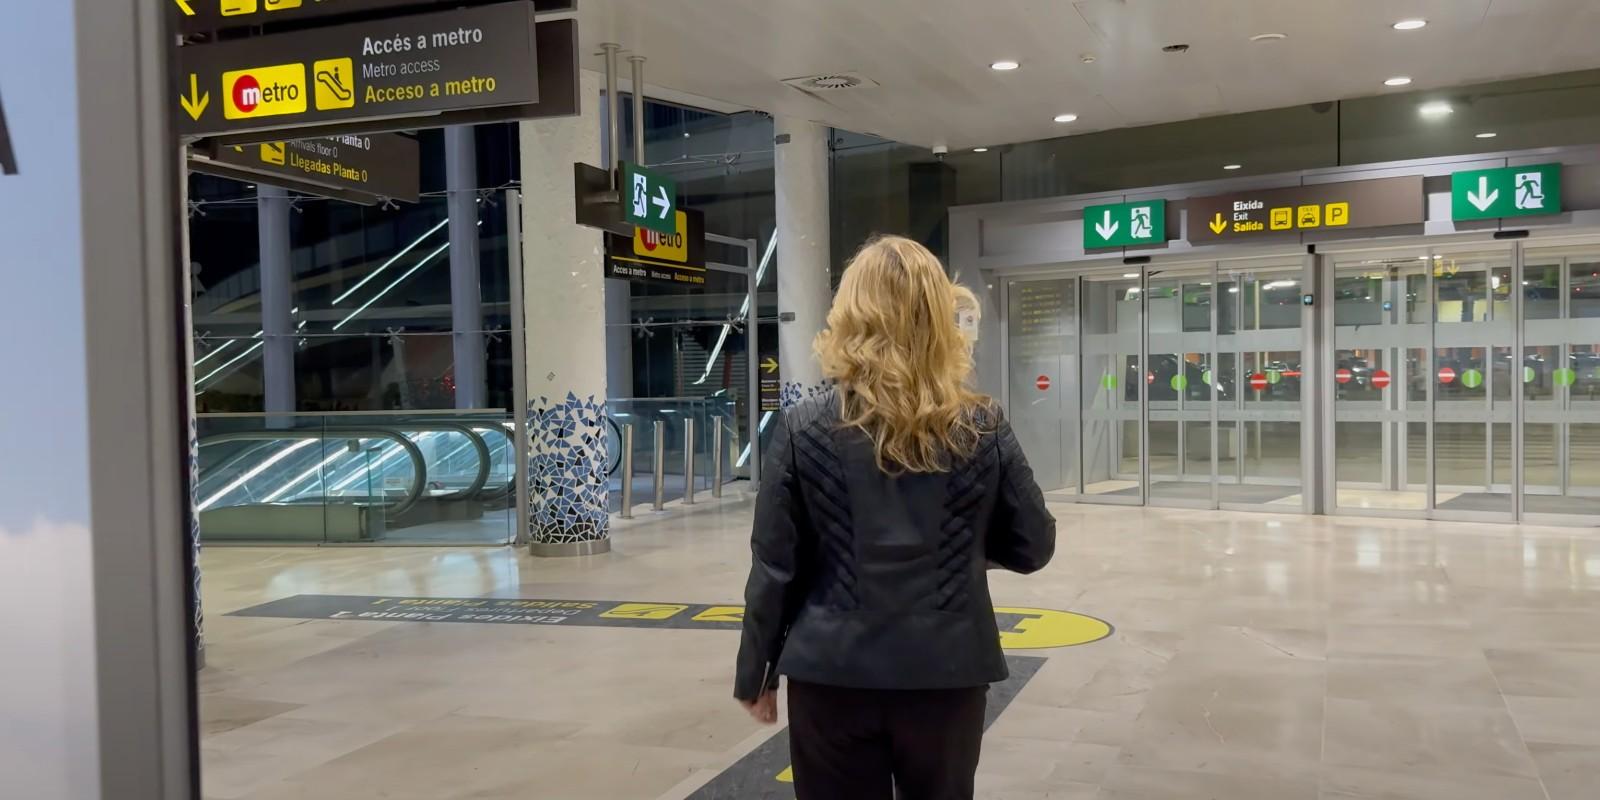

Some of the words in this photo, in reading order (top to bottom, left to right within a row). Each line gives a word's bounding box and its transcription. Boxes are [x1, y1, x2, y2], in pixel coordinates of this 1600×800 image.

[362, 33, 412, 56] Accés
[417, 35, 427, 49] a
[432, 27, 483, 48] metro
[362, 62, 397, 79] Metro
[400, 58, 441, 75] access
[242, 81, 299, 106] metro
[365, 81, 424, 104] Acceso
[429, 82, 440, 97] a
[445, 75, 496, 95] metro
[364, 137, 370, 150] 0
[332, 147, 338, 158] 0
[290, 152, 331, 175] Llegadas
[333, 162, 360, 181] Planta
[361, 169, 368, 183] 0
[1233, 200, 1263, 211] Eixida
[1233, 212, 1248, 221] Exit
[1332, 207, 1342, 222] P
[1233, 221, 1263, 232] Salida
[357, 611, 452, 620] Planta
[457, 614, 568, 624] Eixides
